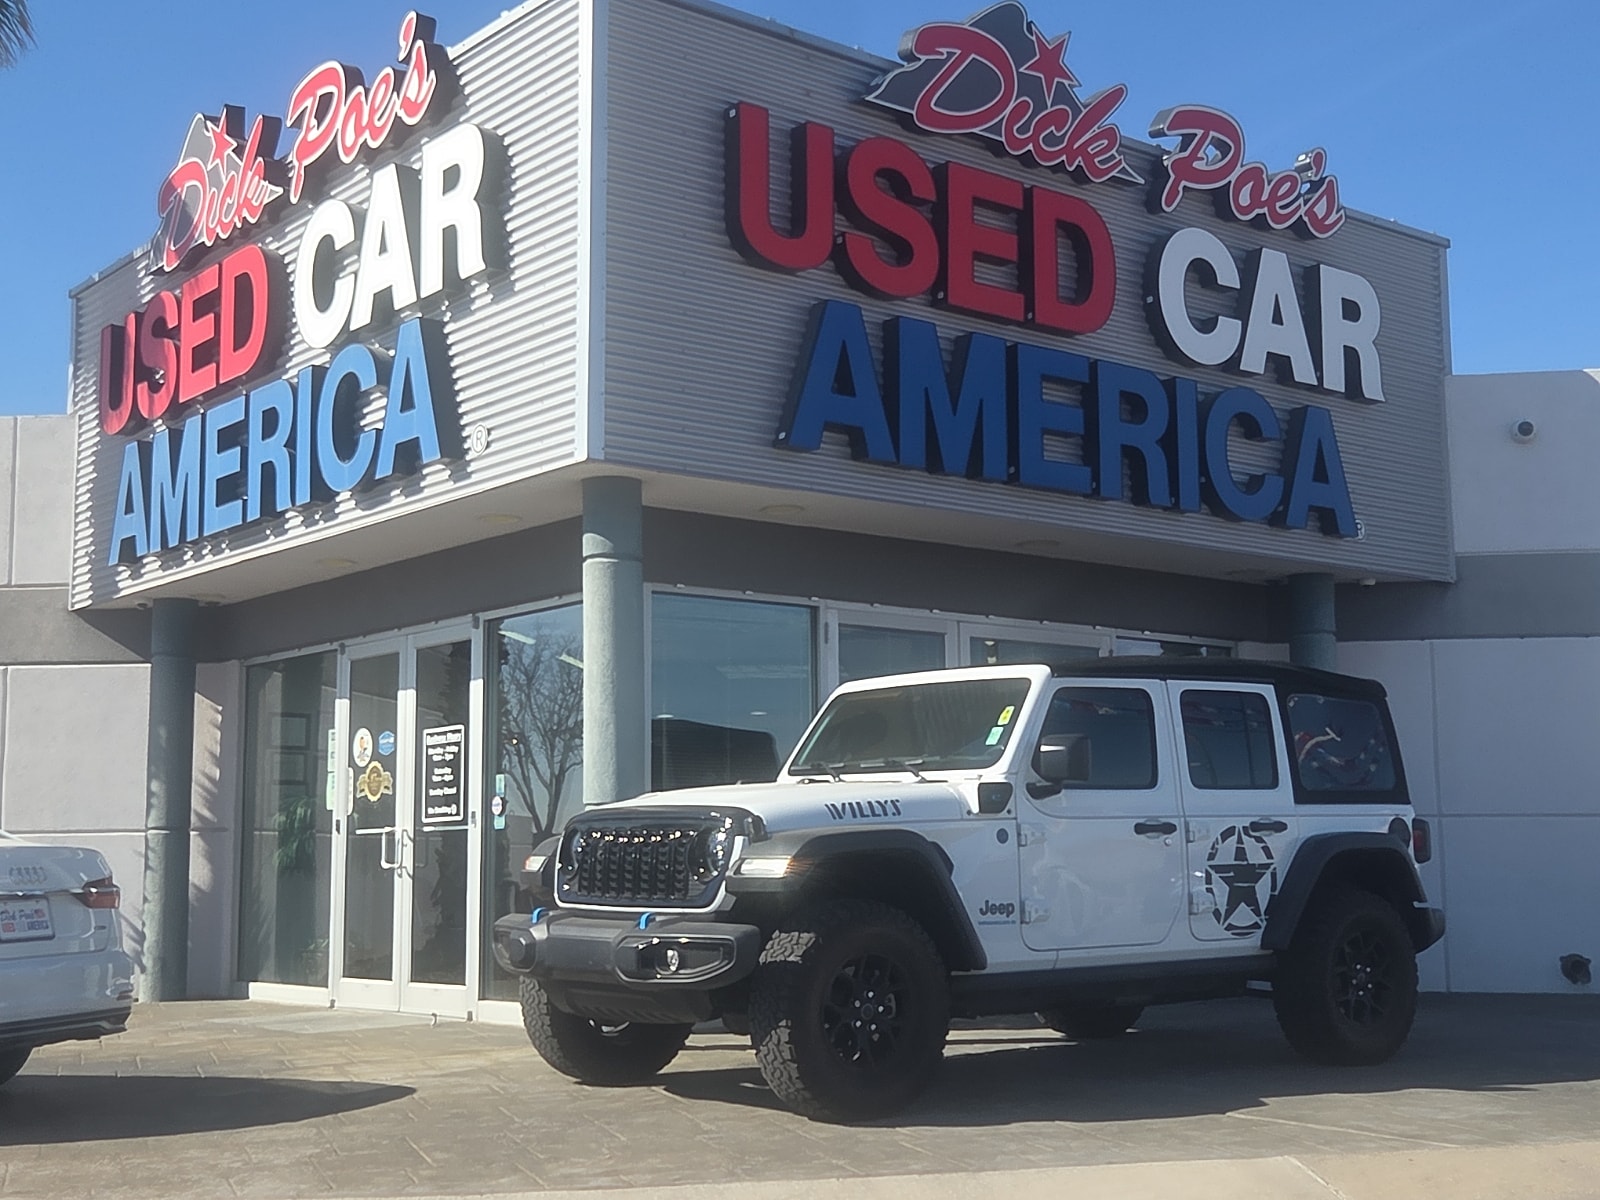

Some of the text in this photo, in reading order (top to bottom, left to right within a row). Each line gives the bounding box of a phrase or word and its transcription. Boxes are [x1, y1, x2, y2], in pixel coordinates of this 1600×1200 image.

[159, 10, 437, 272] Dick Poe's
[737, 101, 1387, 402] USED CAR
[910, 22, 1346, 239] Dick Poe's
[101, 122, 486, 436] USED CAR
[108, 317, 441, 567] AMERICA
[786, 299, 1358, 539] AMERICA
[824, 799, 901, 821] WILLYS
[979, 900, 1015, 918] Jeep
